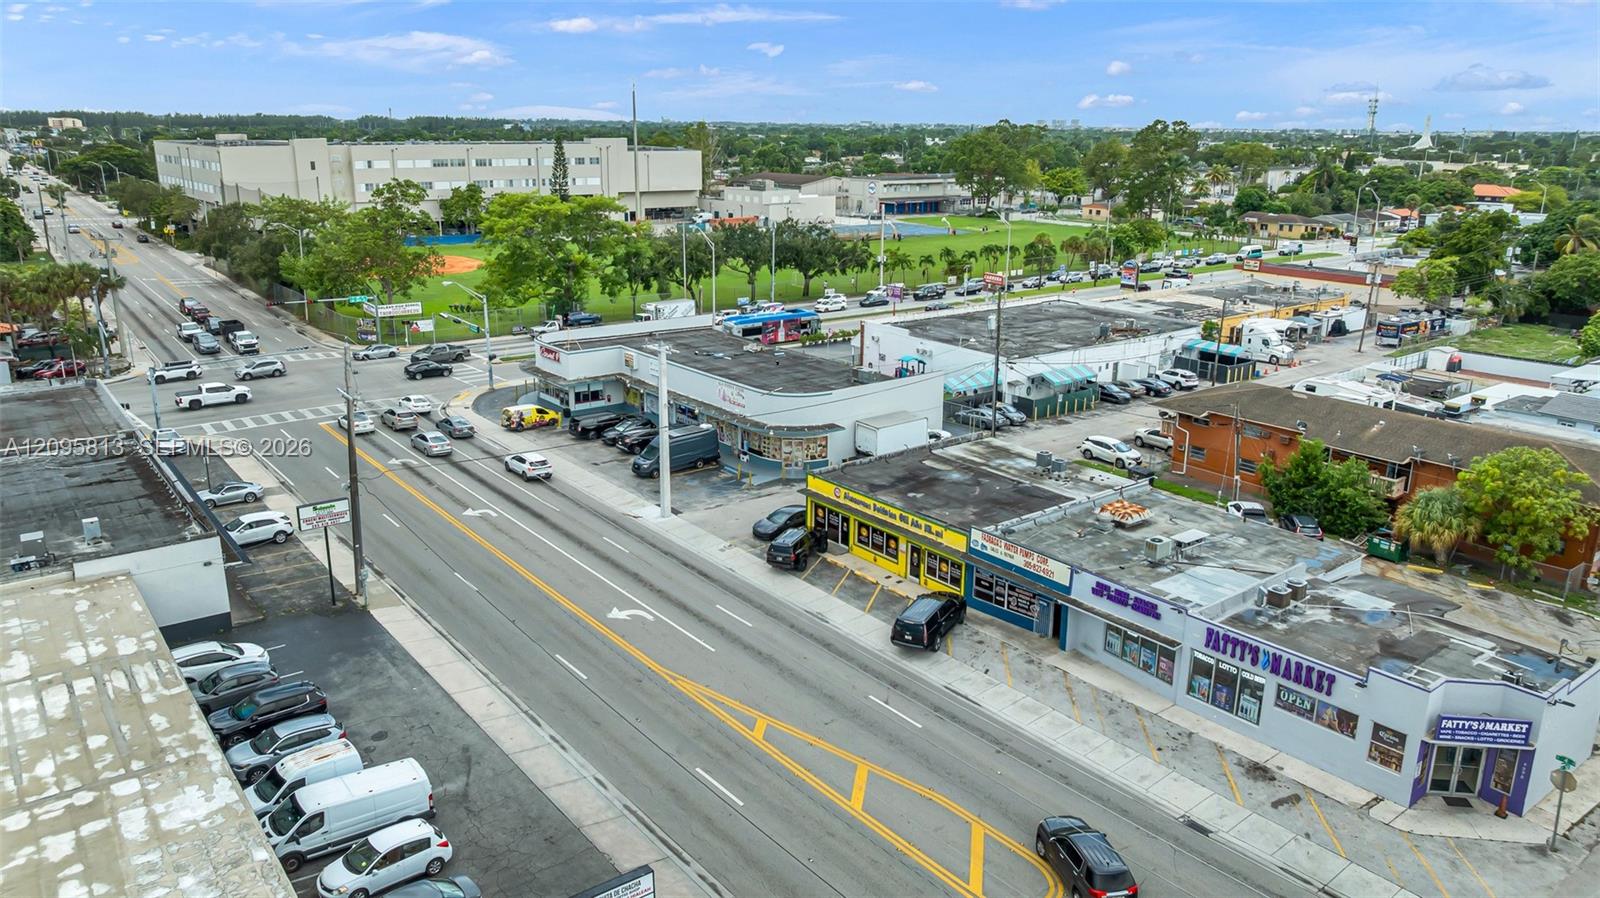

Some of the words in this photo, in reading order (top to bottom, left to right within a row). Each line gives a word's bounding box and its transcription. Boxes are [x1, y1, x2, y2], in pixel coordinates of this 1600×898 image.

[1003, 543, 1018, 555] WATER
[1020, 547, 1035, 561] PUMPS
[1193, 650, 1215, 665] TOBACCO
[1204, 626, 1260, 667] FATTY'S
[1269, 652, 1337, 697] MARKET
[1218, 661, 1238, 675] LOTTO
[1241, 670, 1255, 682] COLD
[1280, 688, 1312, 711] OPEN
[1441, 719, 1479, 731] FATTY'S
[1484, 721, 1529, 733] MARKET
